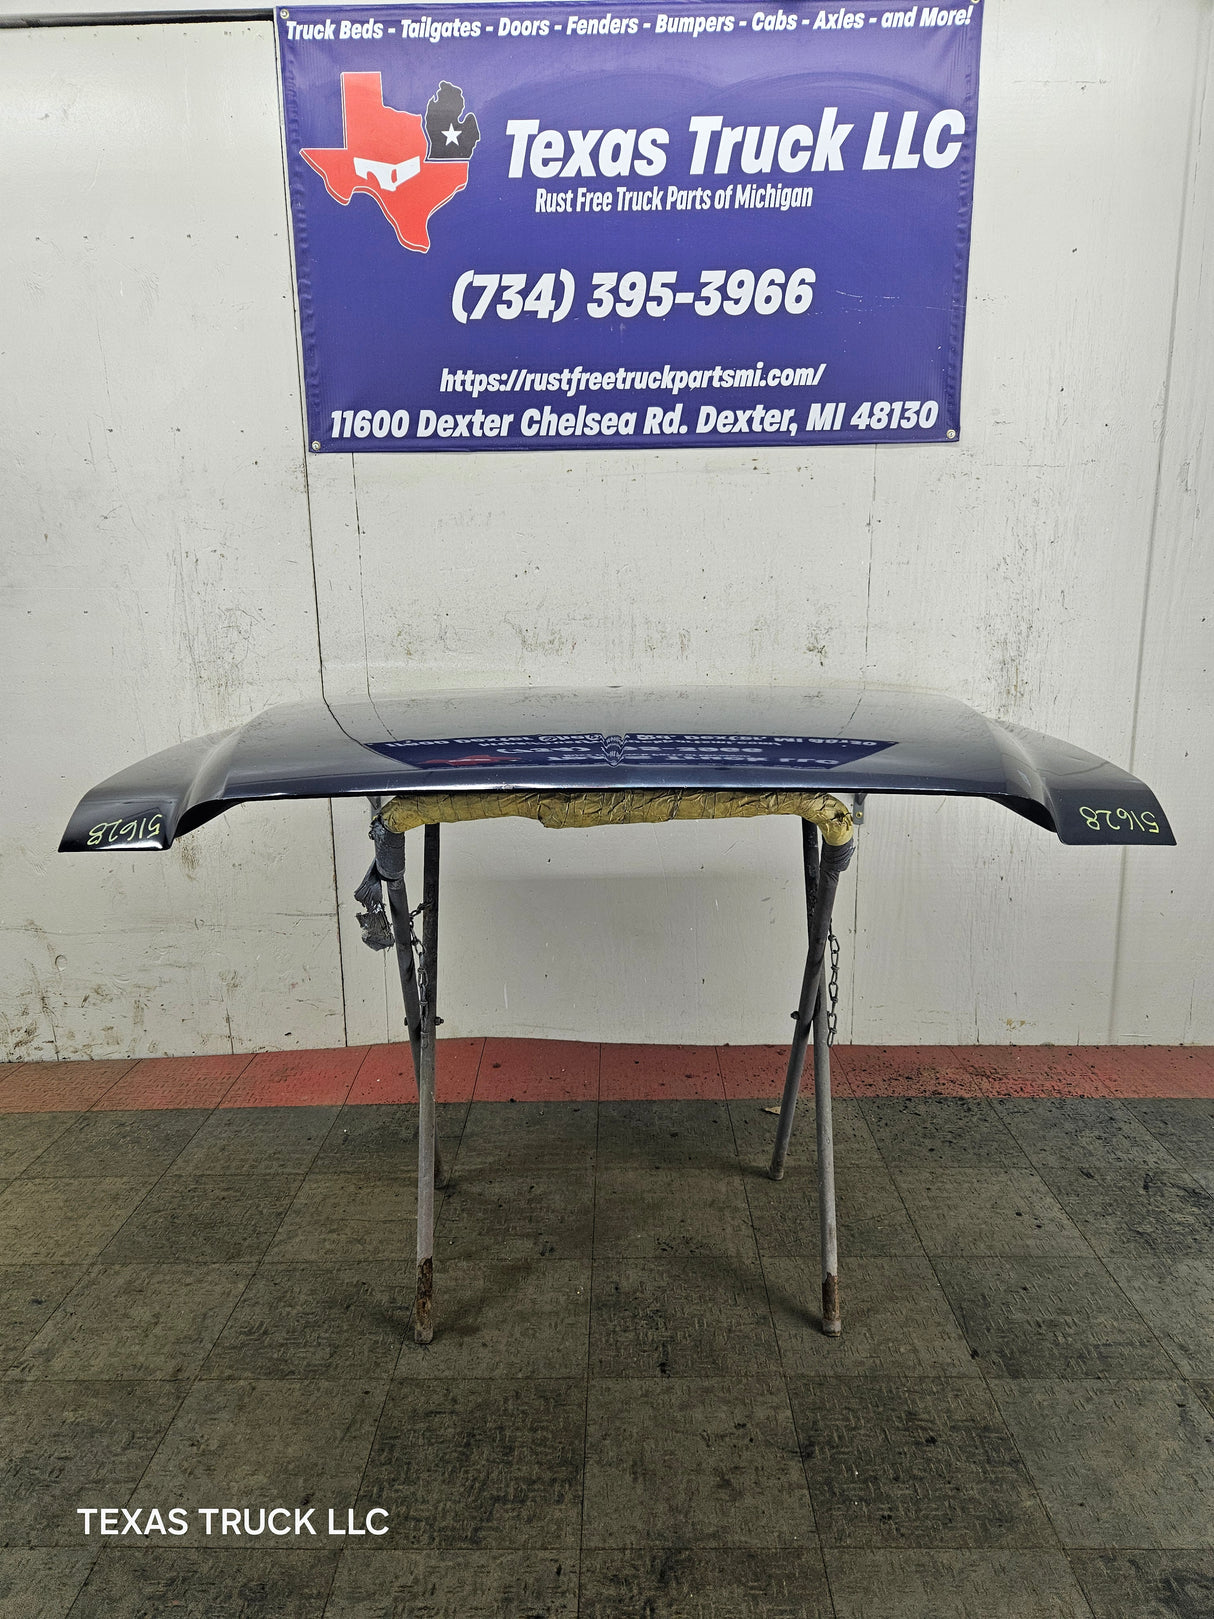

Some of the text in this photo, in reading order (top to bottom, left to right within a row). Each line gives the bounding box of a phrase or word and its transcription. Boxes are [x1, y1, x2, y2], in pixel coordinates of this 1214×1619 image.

[285, 19, 335, 40] Truck
[340, 18, 383, 39] Beds
[401, 16, 481, 42] Tailgates
[498, 18, 550, 36] Doors
[567, 13, 638, 34] Fenders
[655, 14, 735, 37] Bumpers
[752, 10, 797, 31] Cabs
[813, 8, 865, 29] Axles
[881, 6, 918, 28] and
[920, 5, 973, 26] More!
[506, 107, 965, 178] Texas Truck LLC
[536, 183, 813, 212] Rust Free Truck Parts of Michigan
[452, 268, 816, 323] (734) 395-3966
[440, 362, 826, 397] https://rustfreetruckpartsmi.com/
[332, 401, 938, 437] 11600 Dexter Chelsea Rd. Dexter, MI 48130
[87, 814, 163, 845] 51628
[1079, 806, 1159, 833] 51628
